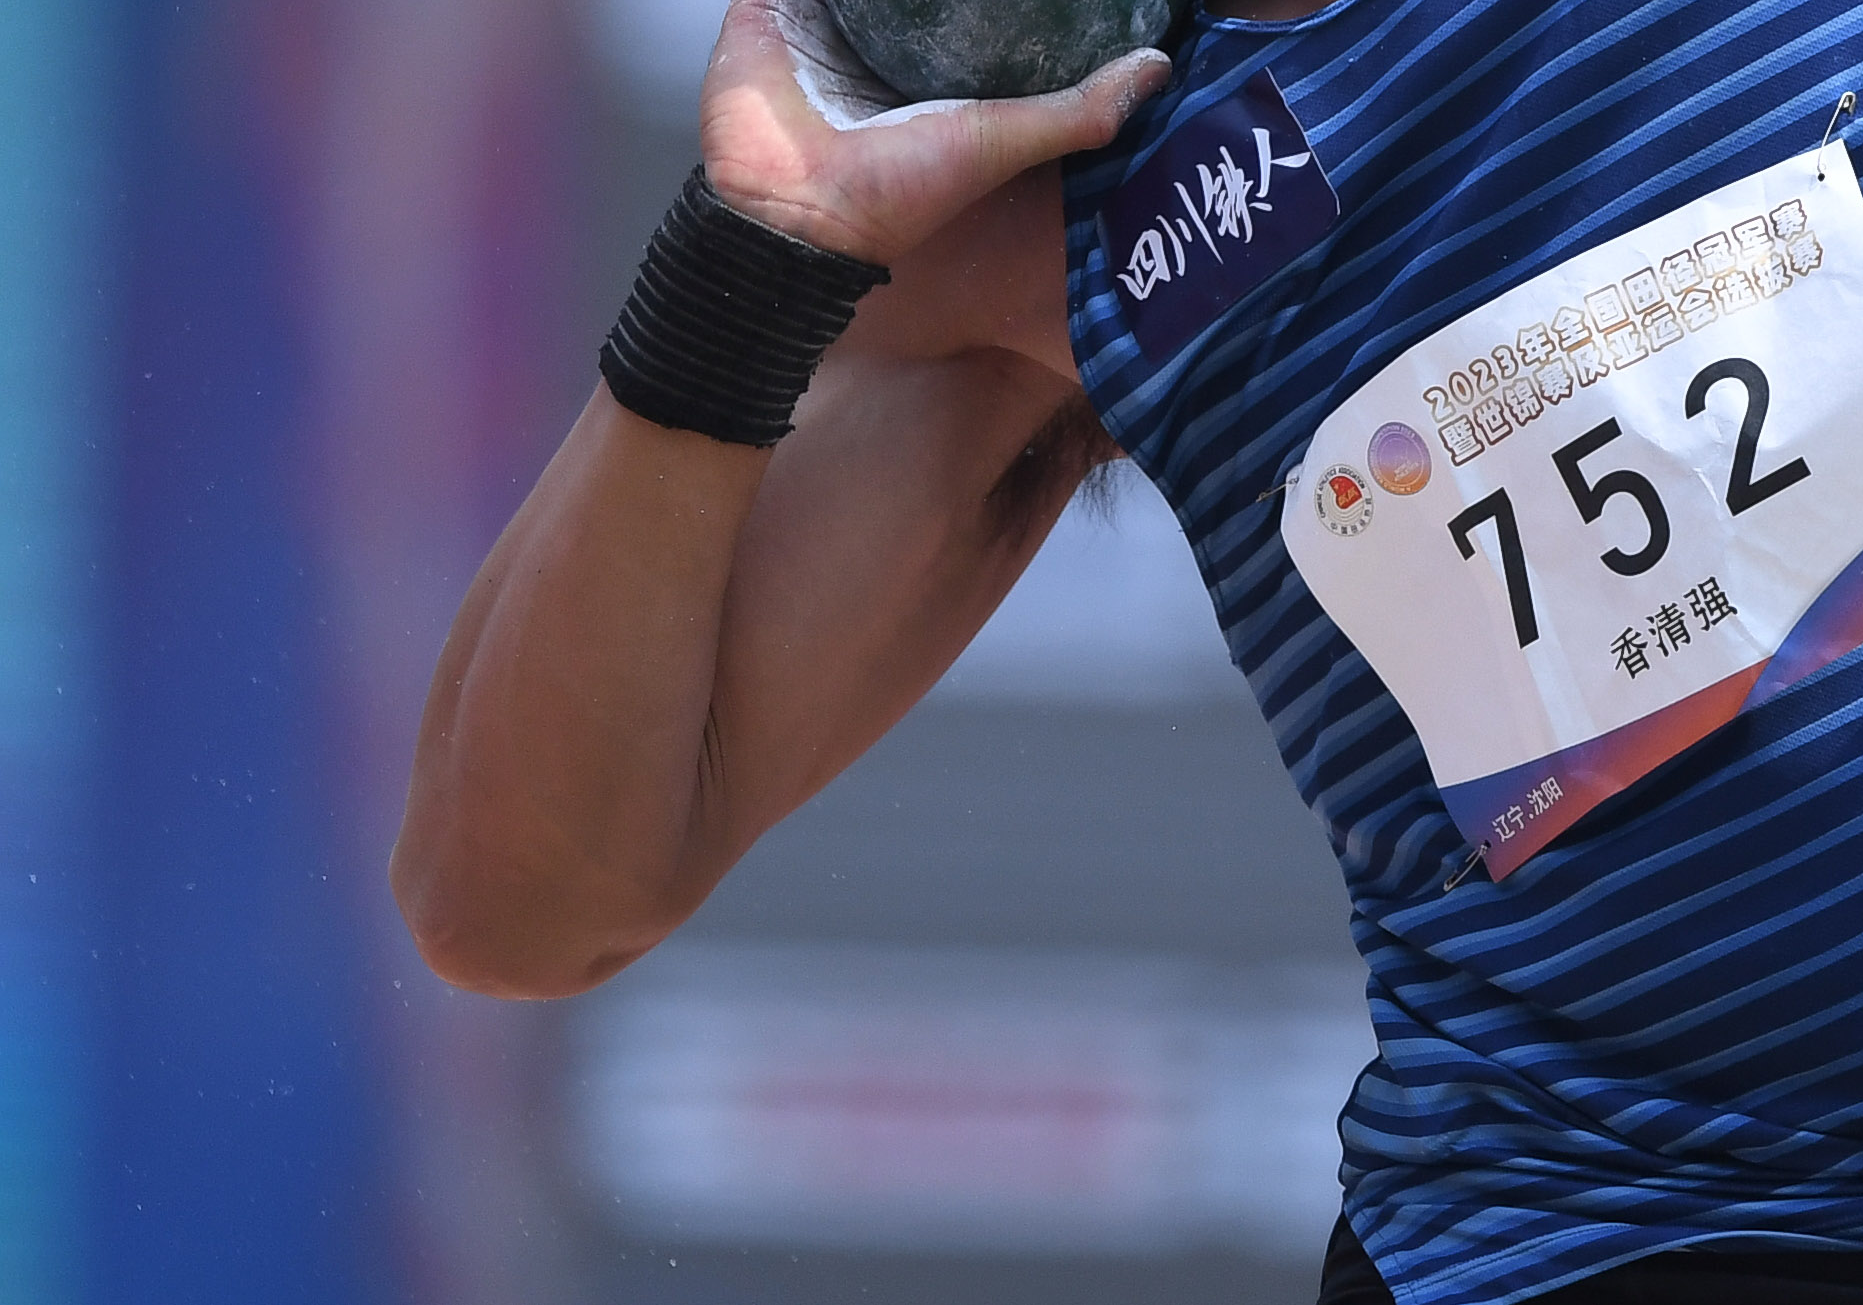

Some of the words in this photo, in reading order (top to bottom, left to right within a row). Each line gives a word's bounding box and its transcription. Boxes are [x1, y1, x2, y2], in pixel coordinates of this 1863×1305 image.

[1117, 128, 1310, 300] 四川铁人
[1424, 199, 1808, 422] 2023年全国田径冠军赛
[1438, 231, 1823, 466] 暨世锦赛及亚运会选拔赛
[1448, 358, 1811, 649] 752
[1610, 577, 1738, 679] 香清强
